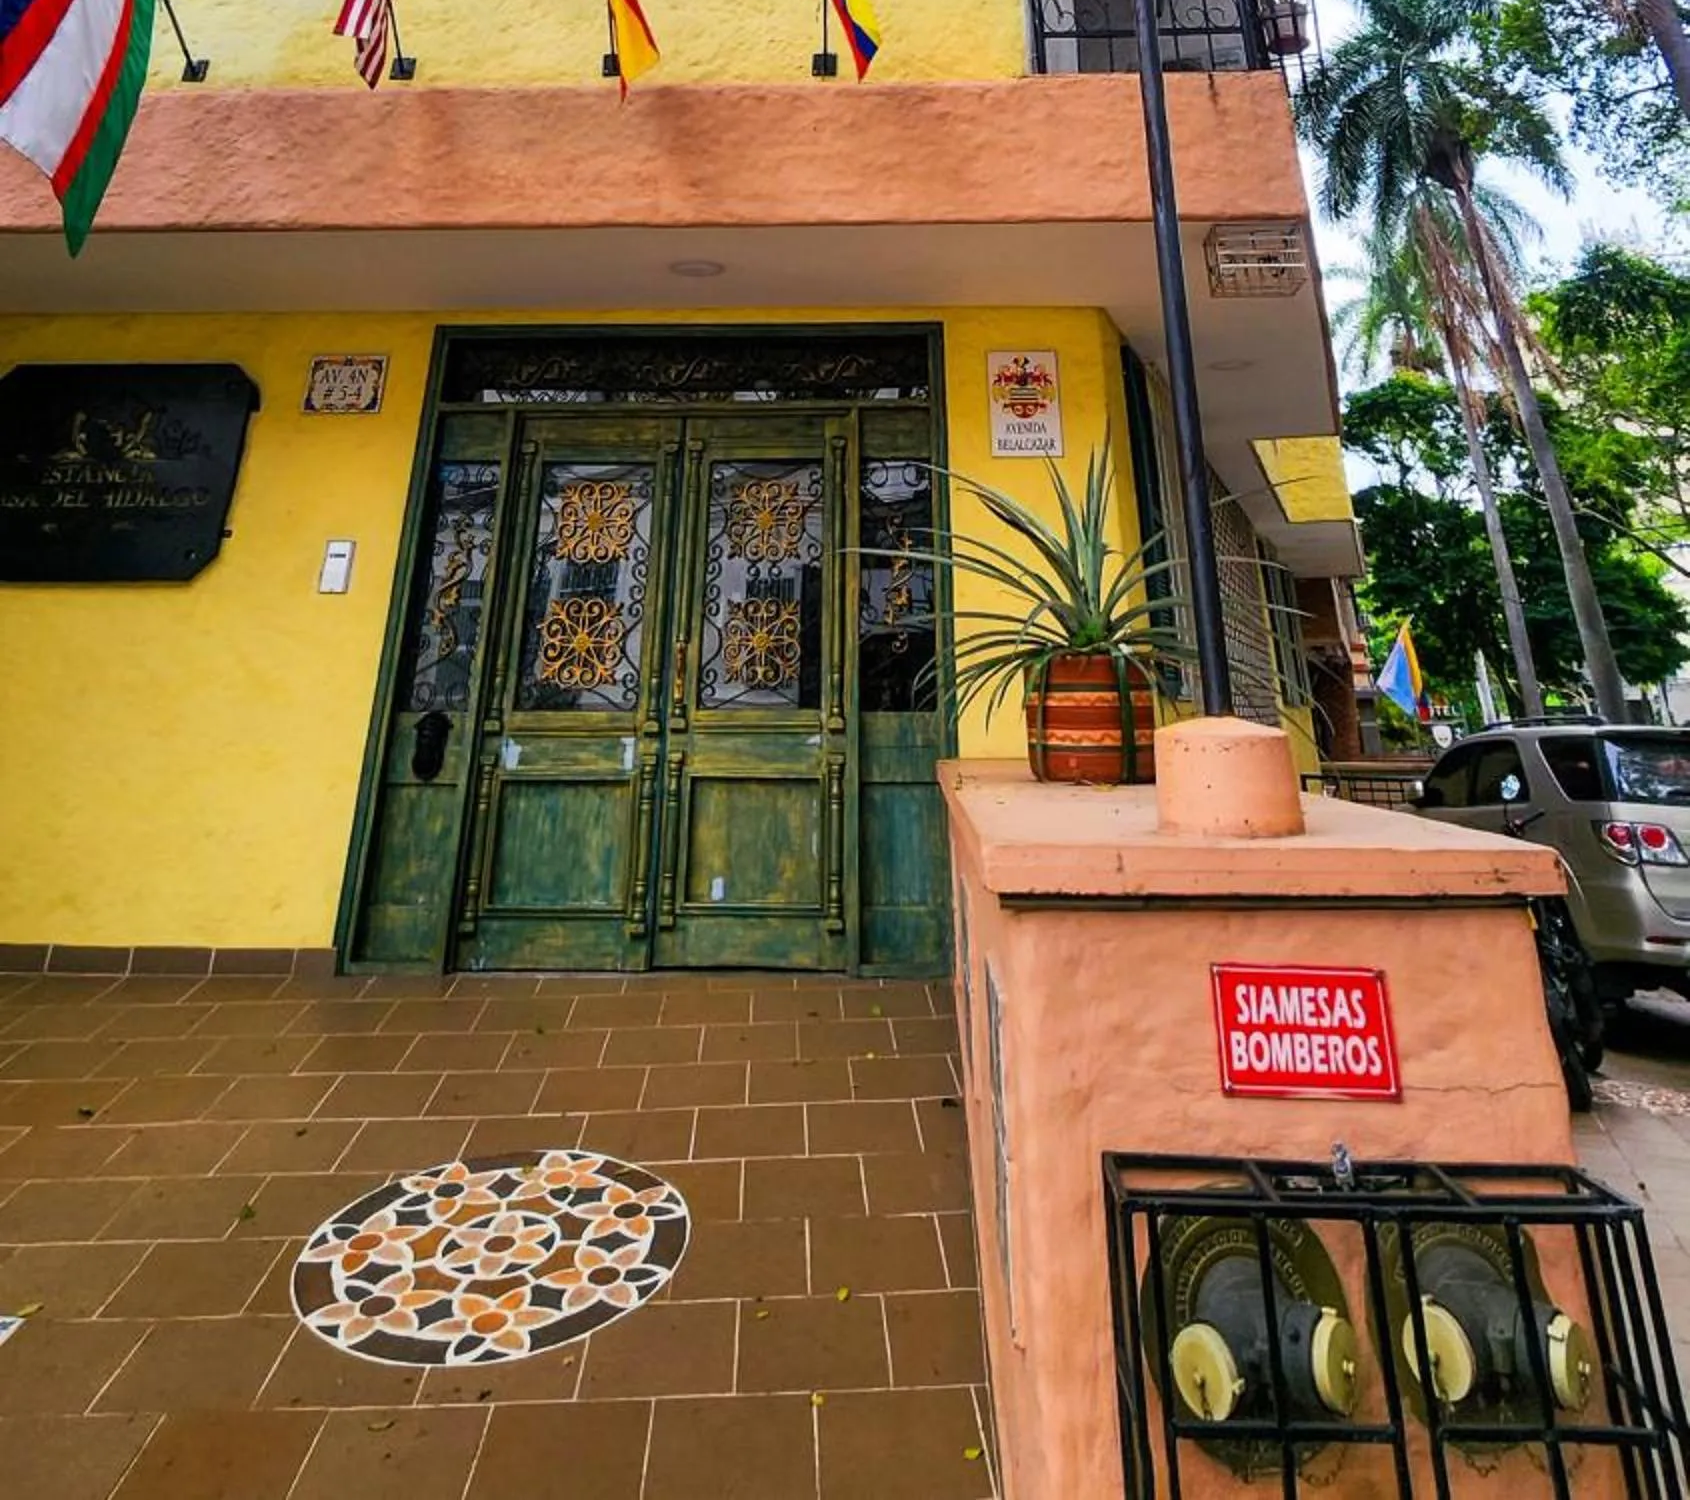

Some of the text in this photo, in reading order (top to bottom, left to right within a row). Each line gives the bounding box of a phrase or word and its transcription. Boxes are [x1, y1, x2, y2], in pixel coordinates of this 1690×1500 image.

[1006, 420, 1048, 436] AVENIDA
[1234, 983, 1368, 1029] SIAMESAS
[1229, 1030, 1384, 1077] BOMBEROS
